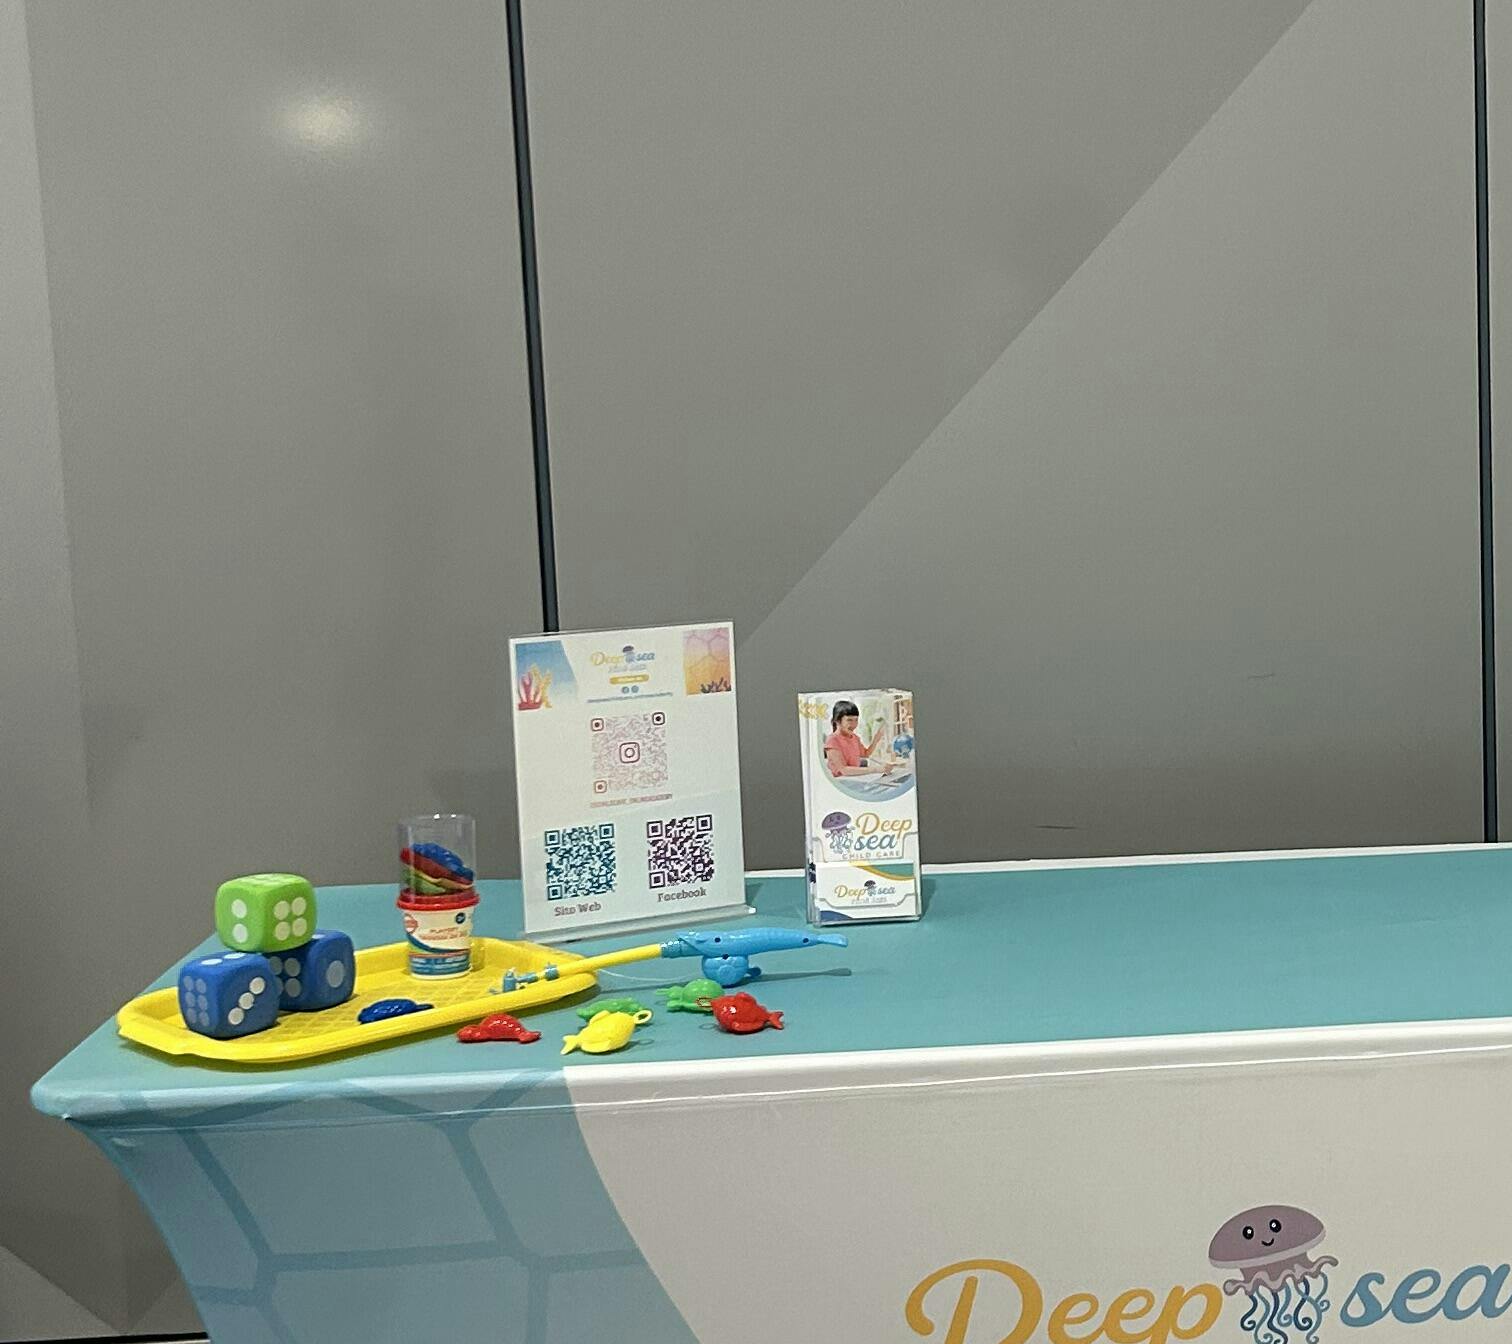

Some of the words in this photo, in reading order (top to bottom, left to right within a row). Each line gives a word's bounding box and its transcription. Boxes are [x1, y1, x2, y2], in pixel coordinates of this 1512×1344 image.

[856, 812, 912, 840] Deep
[854, 834, 898, 850] sea
[657, 888, 707, 902] Facebook
[578, 902, 601, 912] Web
